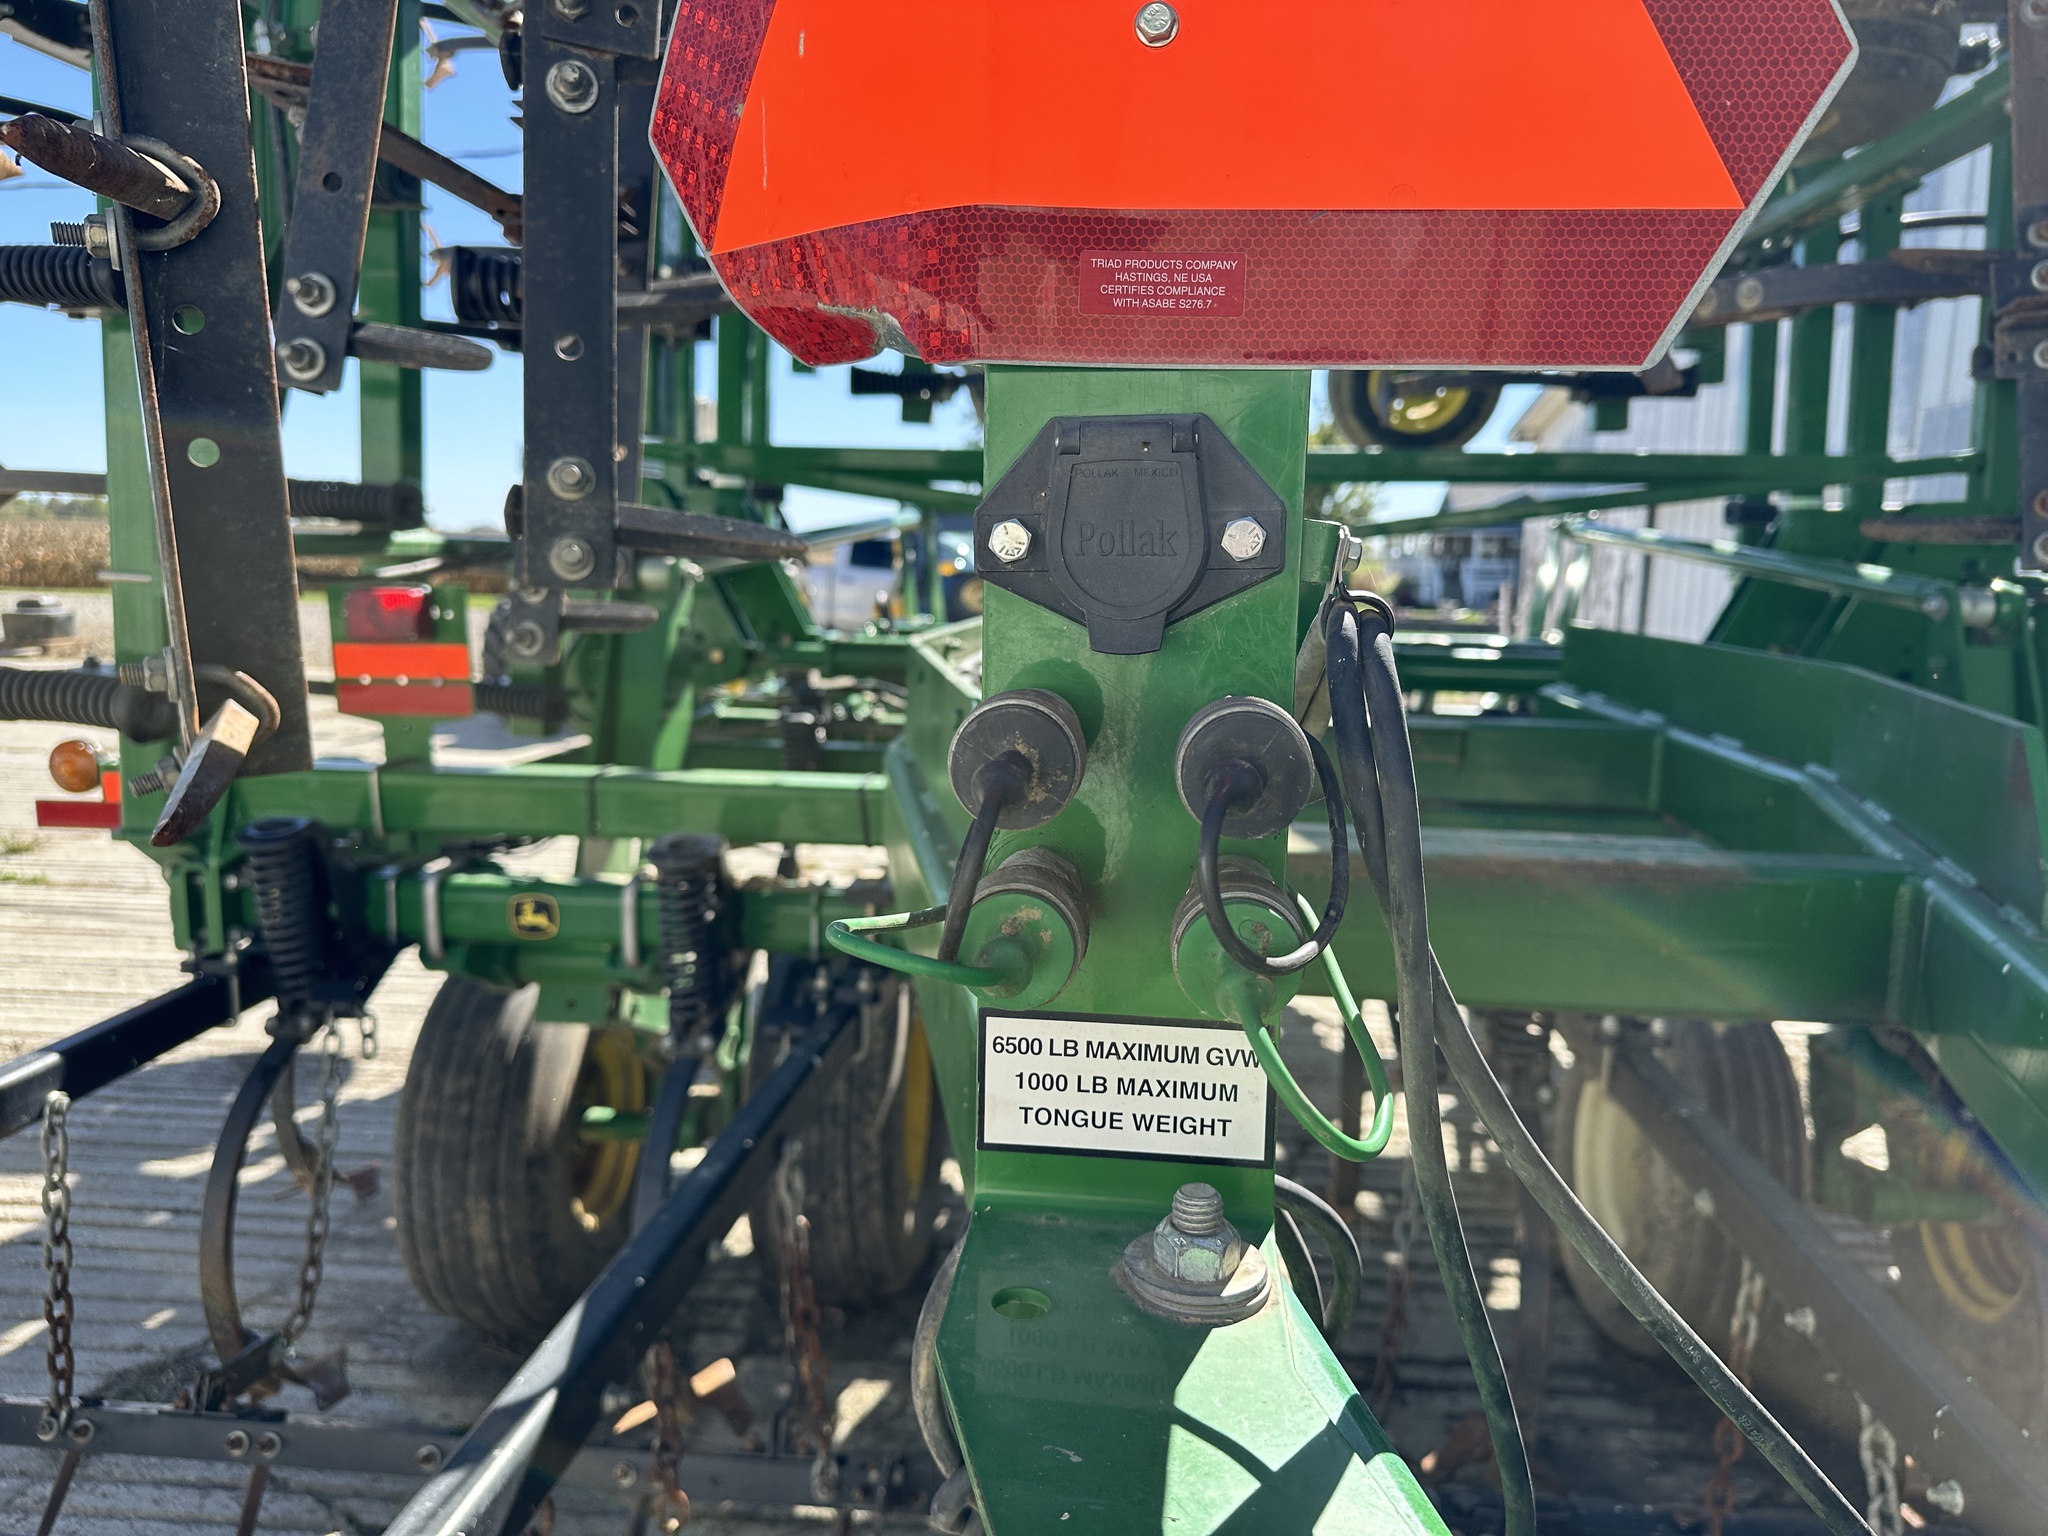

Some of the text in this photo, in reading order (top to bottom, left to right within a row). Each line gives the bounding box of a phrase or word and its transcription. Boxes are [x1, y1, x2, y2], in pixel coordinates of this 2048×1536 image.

[1091, 258, 1238, 270] TRIAD PRODUCTS COMPANY
[1115, 272, 1213, 283] HASTINGS, NE USA
[1100, 284, 1226, 296] CERTIFIES COMPLIANCE
[1113, 298, 1212, 309] WITH ASABE S276.7
[1074, 467, 1179, 479] POLLAK MEXICO
[1075, 519, 1178, 557] Pollak
[992, 1035, 1043, 1056] 6500
[1049, 1038, 1079, 1058] LB
[1085, 1040, 1200, 1065] MAXIMUM
[1015, 1071, 1238, 1103] 1000 LB MAXIMUM
[1019, 1106, 1233, 1137] TONGUE WEIGHT
